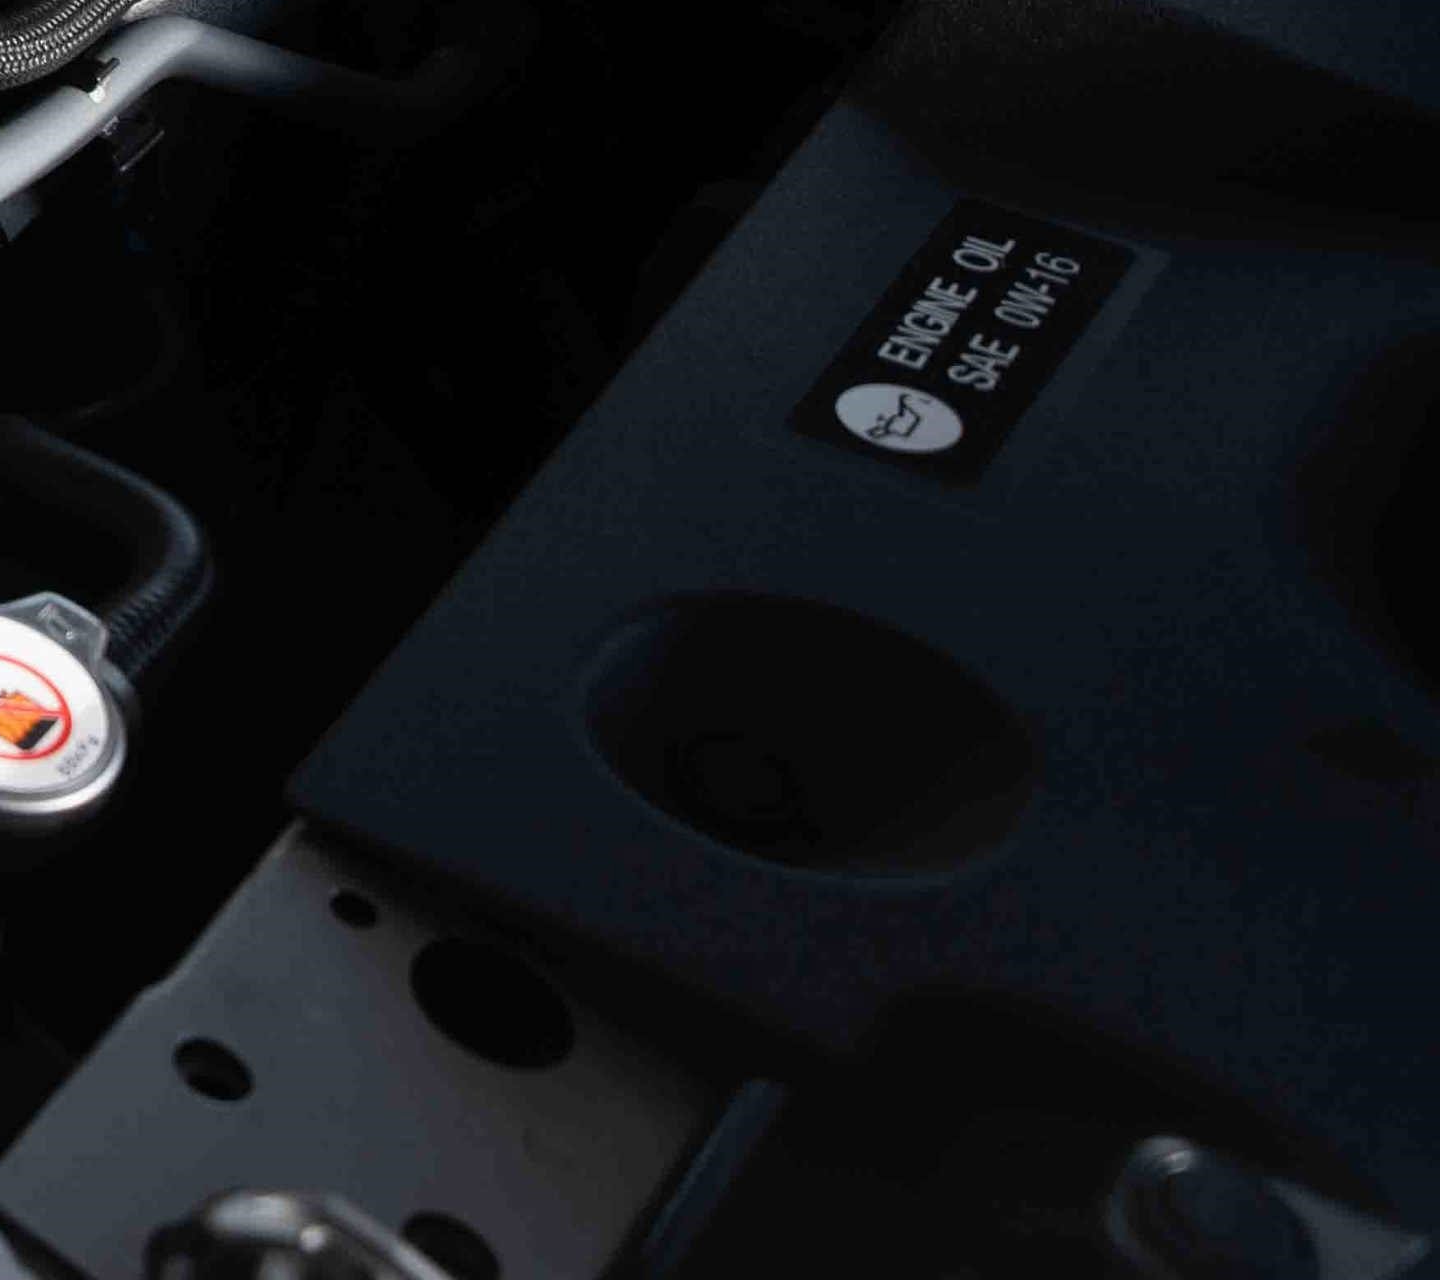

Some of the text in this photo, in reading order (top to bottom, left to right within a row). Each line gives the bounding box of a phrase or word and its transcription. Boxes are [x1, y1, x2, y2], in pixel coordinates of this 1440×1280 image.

[877, 234, 1016, 370] ENGINE OIL
[947, 251, 1083, 392] SAE 0W-16
